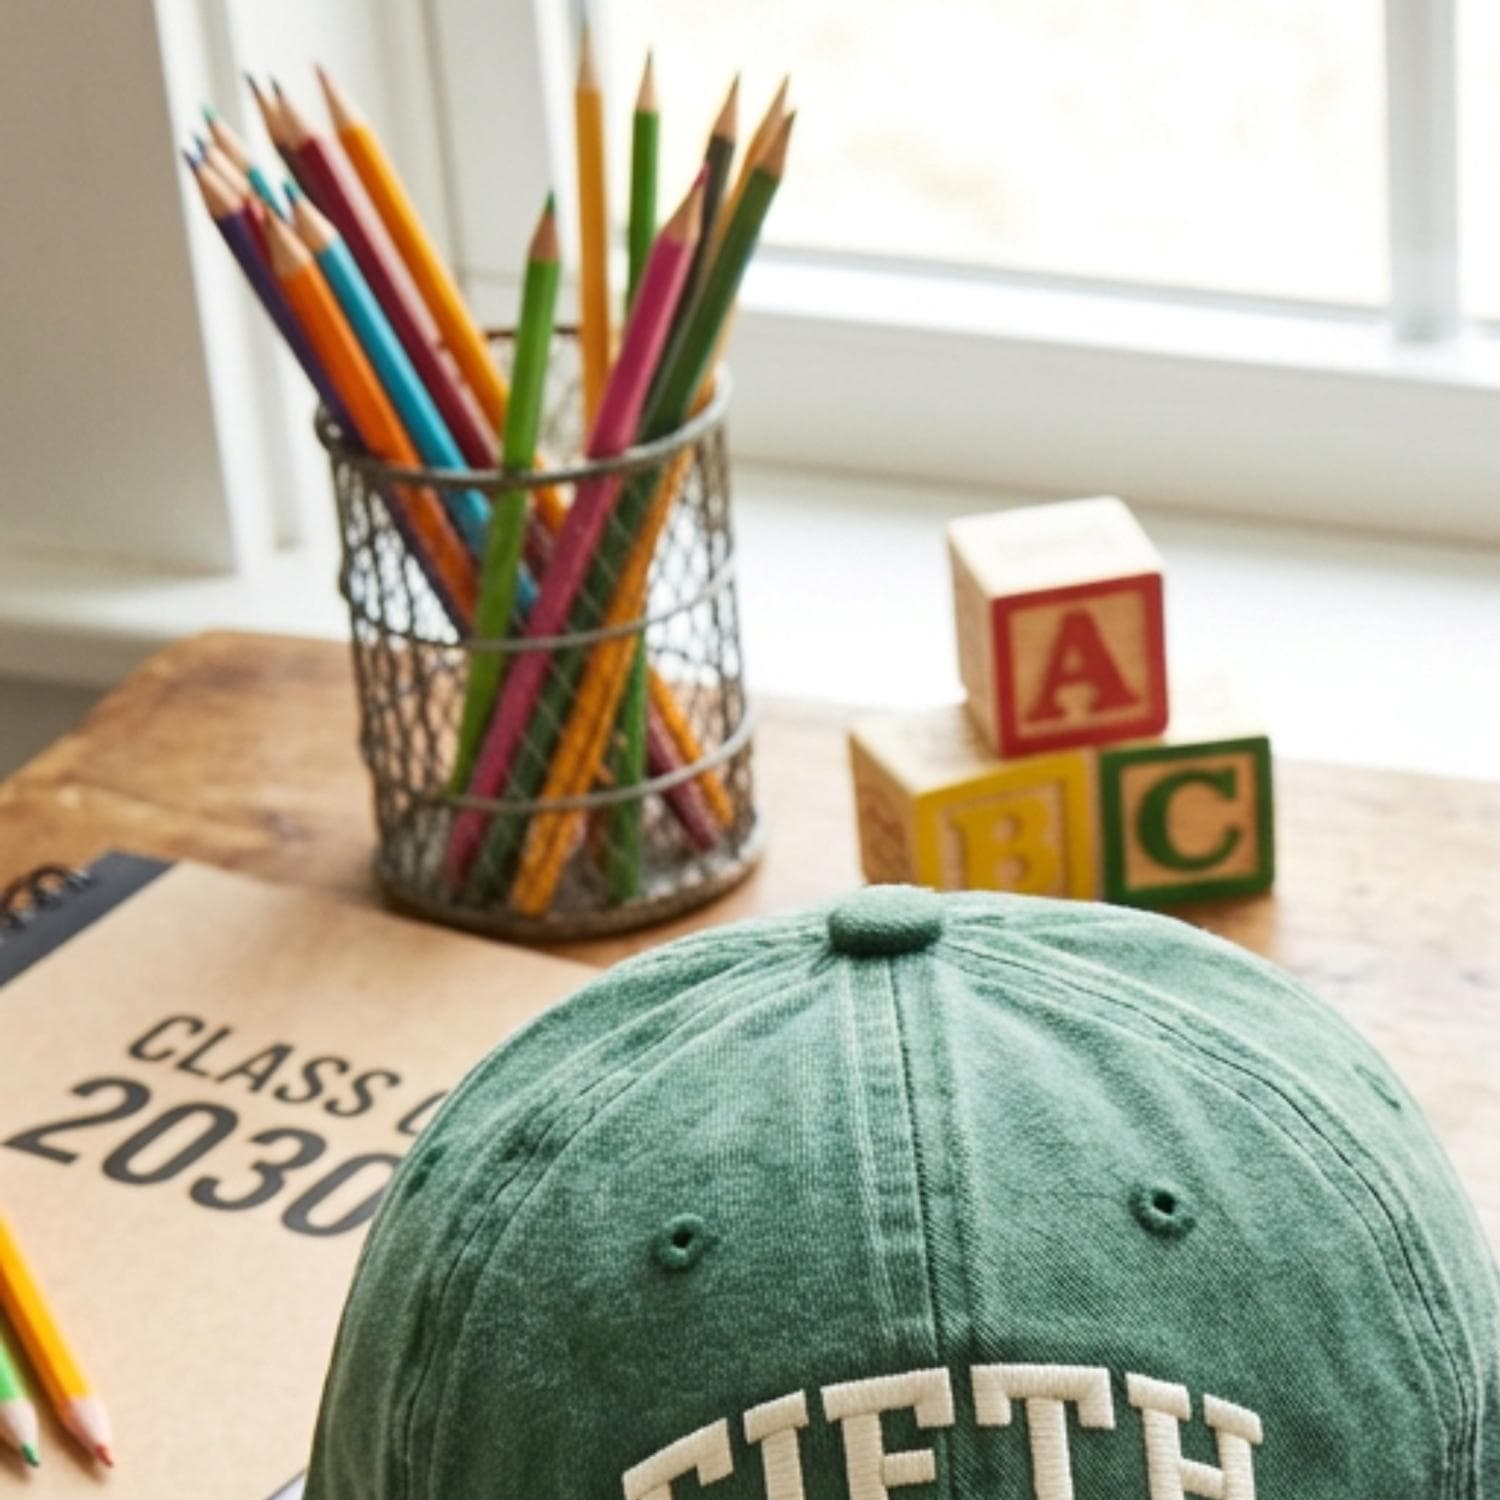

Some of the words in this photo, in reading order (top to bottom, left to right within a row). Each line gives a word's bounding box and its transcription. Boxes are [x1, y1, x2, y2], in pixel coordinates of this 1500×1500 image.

[1022, 607, 1142, 725] A
[950, 797, 1060, 893] B
[1135, 767, 1243, 872] C
[127, 1013, 402, 1118] CLASS
[3, 1075, 403, 1237] 2030
